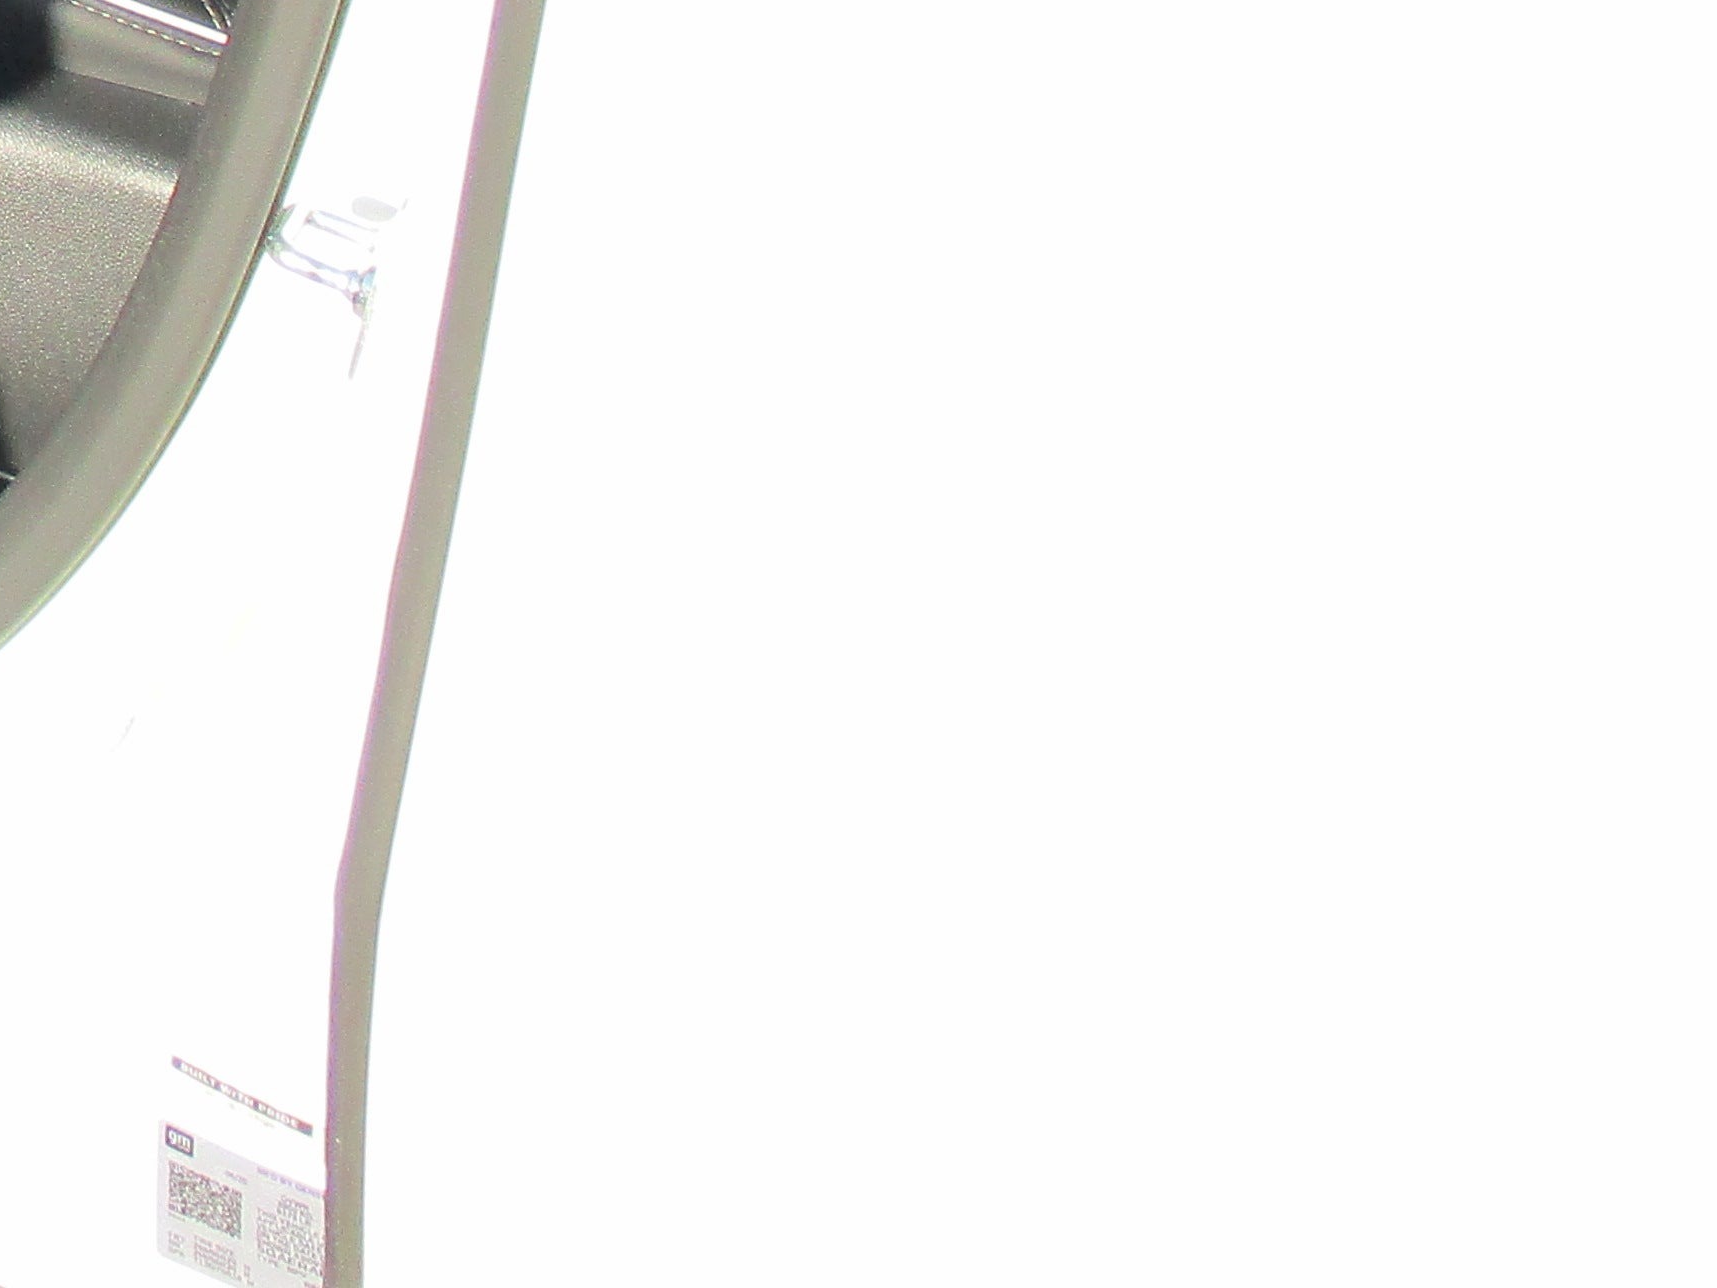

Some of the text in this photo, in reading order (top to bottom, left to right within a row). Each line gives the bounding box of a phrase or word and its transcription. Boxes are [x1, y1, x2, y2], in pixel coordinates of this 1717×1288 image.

[180, 1062, 216, 1089] BUILT
[219, 1085, 254, 1107] WITH
[258, 1104, 299, 1128] PRIDE
